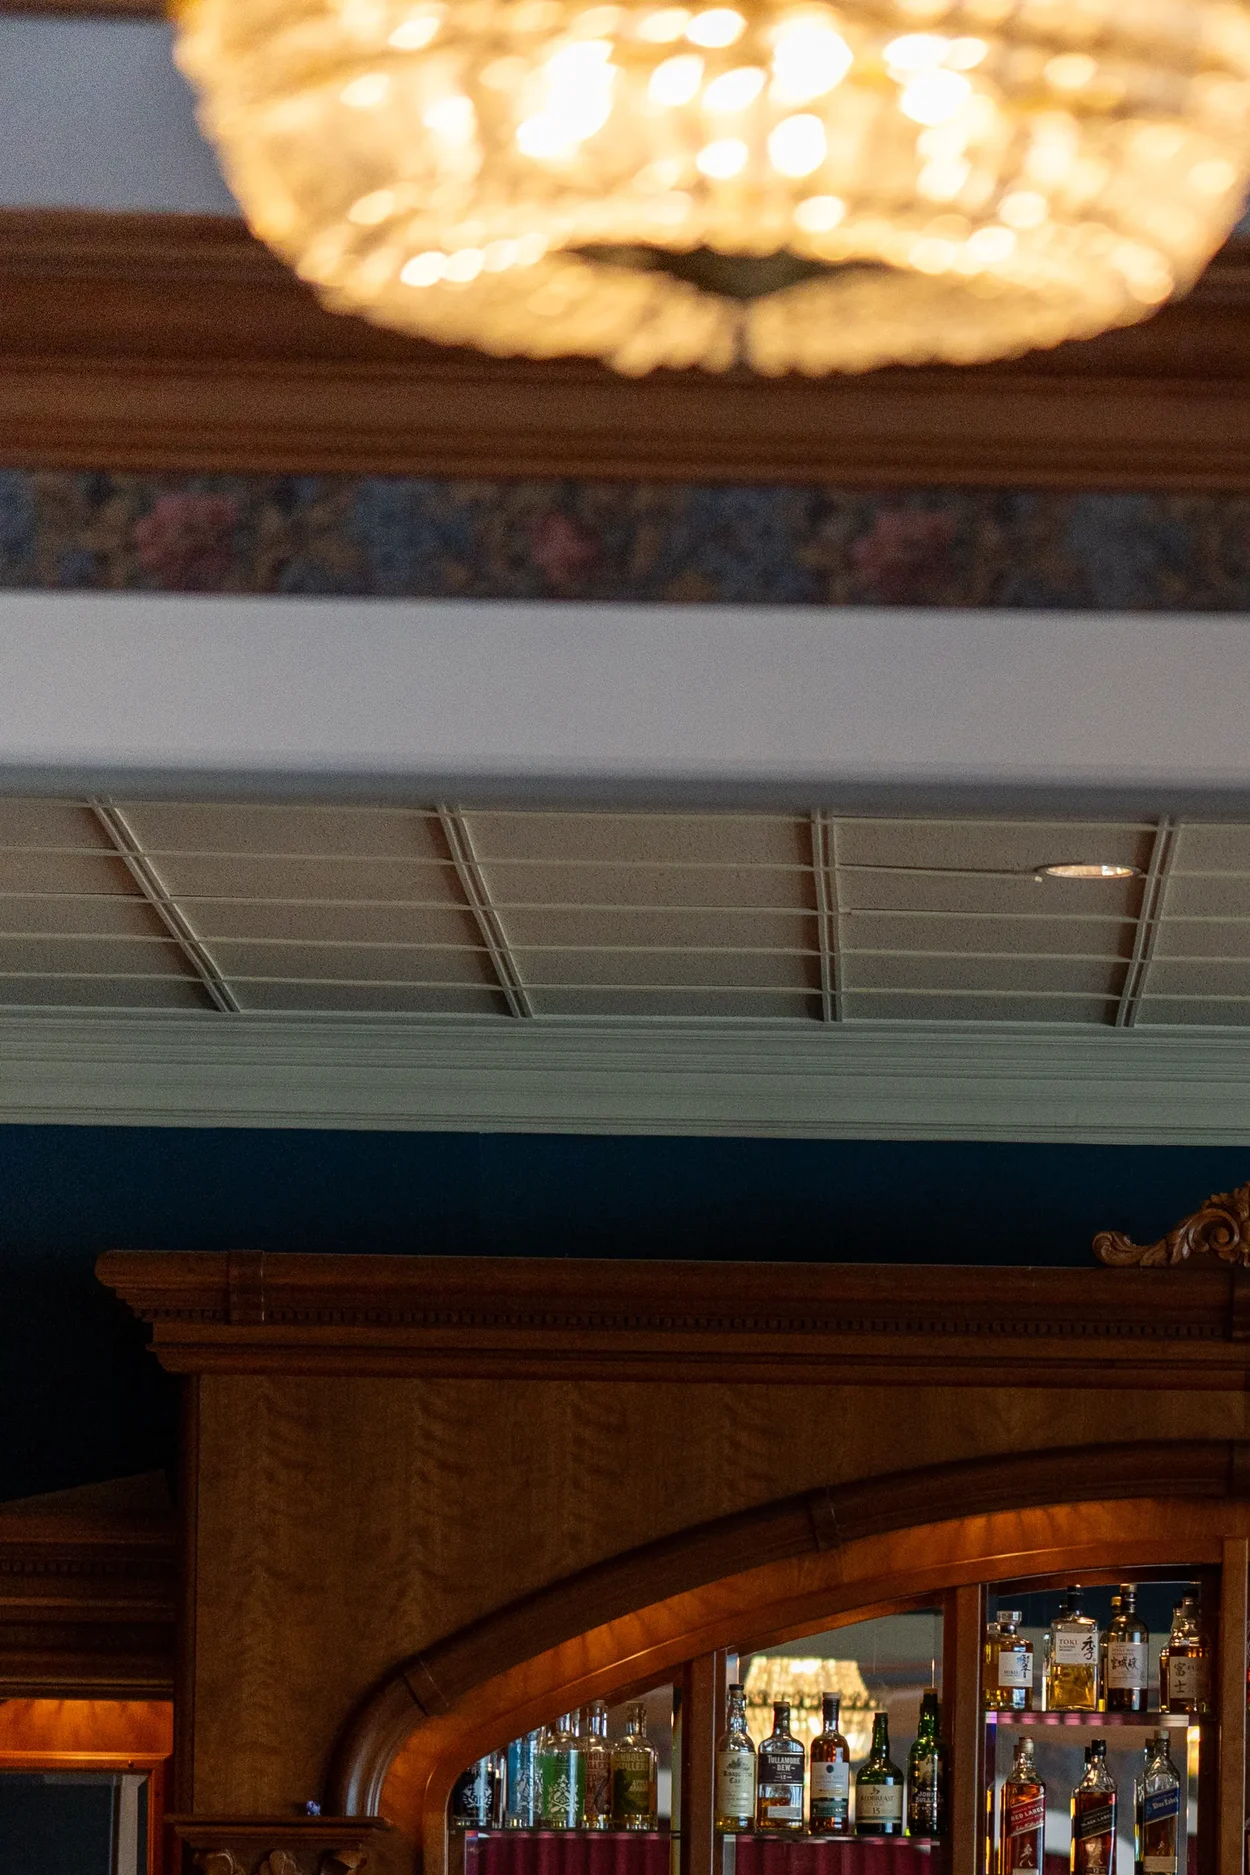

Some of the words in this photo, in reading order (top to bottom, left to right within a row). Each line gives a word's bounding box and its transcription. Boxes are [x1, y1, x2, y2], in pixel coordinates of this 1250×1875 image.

[768, 1754, 801, 1764] TULLAMORE
[872, 1807, 881, 1815] 15
[1011, 1813, 1024, 1822] RED
[1025, 1806, 1044, 1817] LABEL
